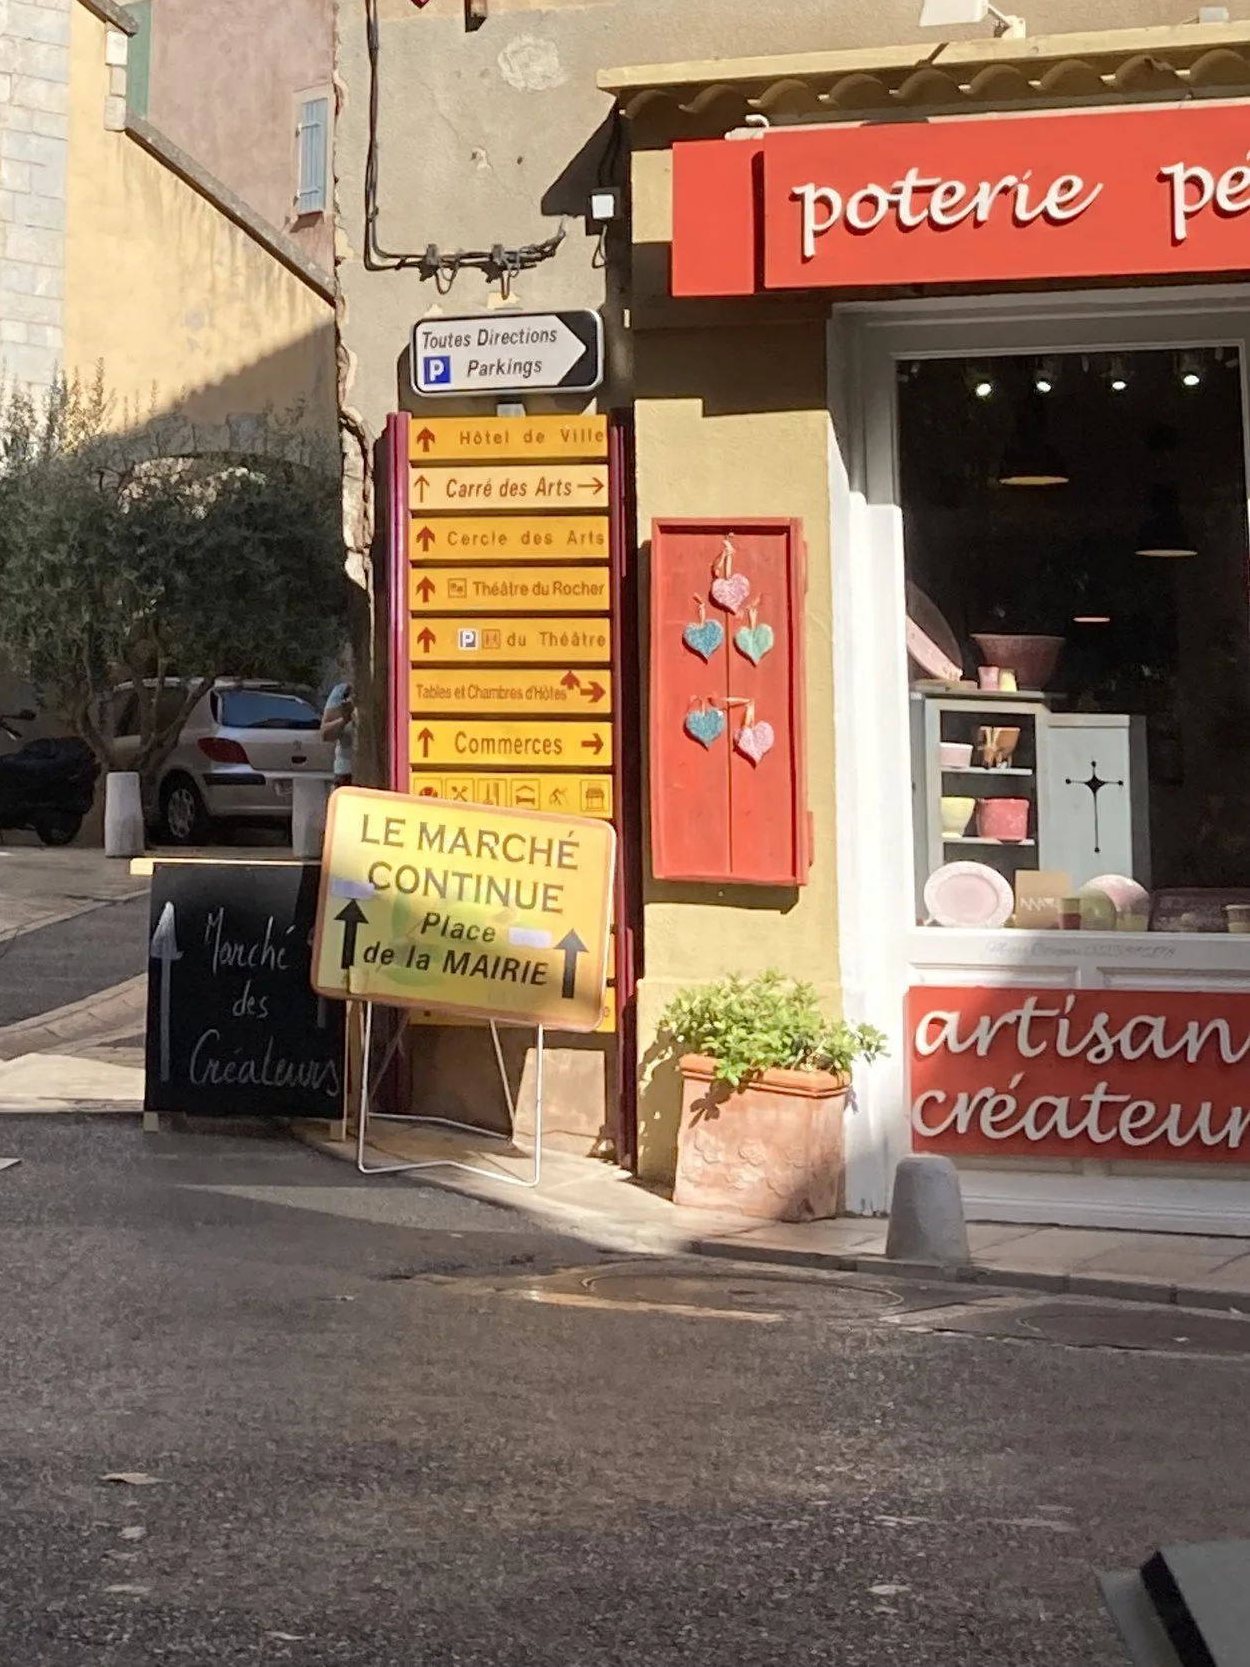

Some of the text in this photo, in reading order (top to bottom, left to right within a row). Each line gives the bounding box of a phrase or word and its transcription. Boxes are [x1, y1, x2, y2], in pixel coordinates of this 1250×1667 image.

[791, 168, 1104, 258] poterie
[422, 328, 557, 350] Toutes Directions
[467, 359, 542, 379] Parkings
[460, 427, 604, 445] Hôtel de Ville
[446, 475, 572, 498] Carré des Arts
[447, 529, 604, 546] Cercle des Arts
[473, 581, 605, 596] Théâtre du Rocher
[507, 633, 526, 647] du
[539, 631, 606, 647] Théâtre
[416, 684, 451, 699] Tables
[454, 684, 466, 699] et
[467, 684, 523, 700] Chambres
[455, 731, 563, 755] Commerces
[360, 814, 580, 870] LE MARCHÉ
[368, 861, 564, 914] CONTINUE
[420, 912, 496, 943] Place
[205, 907, 296, 974] Marché
[363, 941, 549, 986] de la MAIRIE
[232, 980, 269, 1019] des
[189, 1029, 339, 1097] Créateurs
